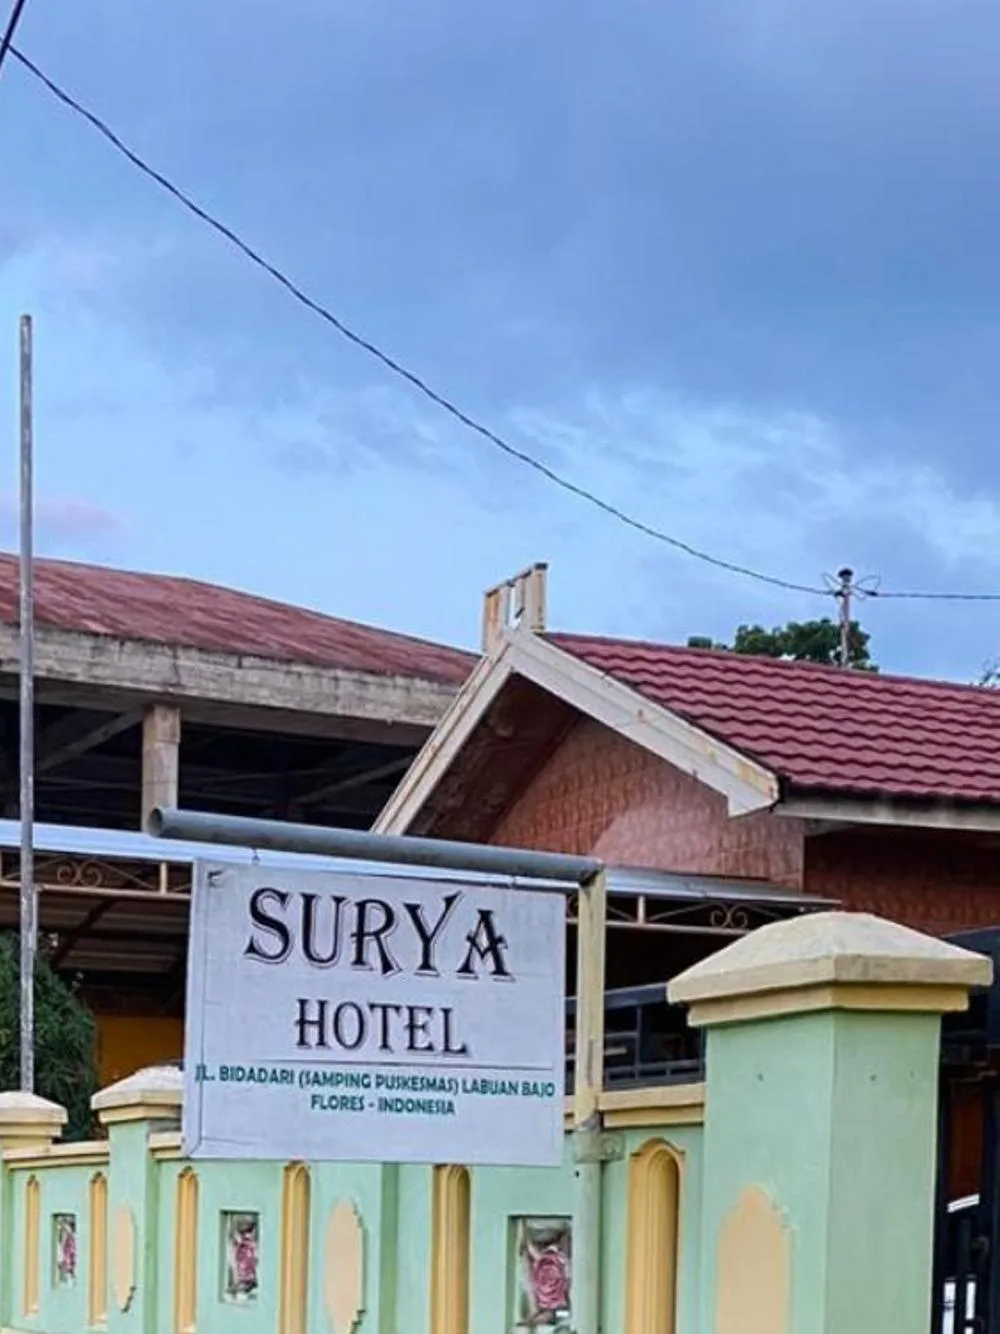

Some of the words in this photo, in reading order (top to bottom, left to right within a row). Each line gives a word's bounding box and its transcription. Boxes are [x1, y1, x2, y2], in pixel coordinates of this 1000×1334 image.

[244, 887, 517, 983] SURYA
[293, 998, 470, 1056] HOTEL
[219, 1065, 294, 1085] BIDADARI
[299, 1070, 371, 1089] (SAMPING
[375, 1073, 459, 1096] PUSKESMAS)
[462, 1078, 517, 1096] LABUAN
[521, 1081, 555, 1098] BAJO
[310, 1094, 364, 1111] FLORES
[378, 1097, 455, 1115] INDONESIA
